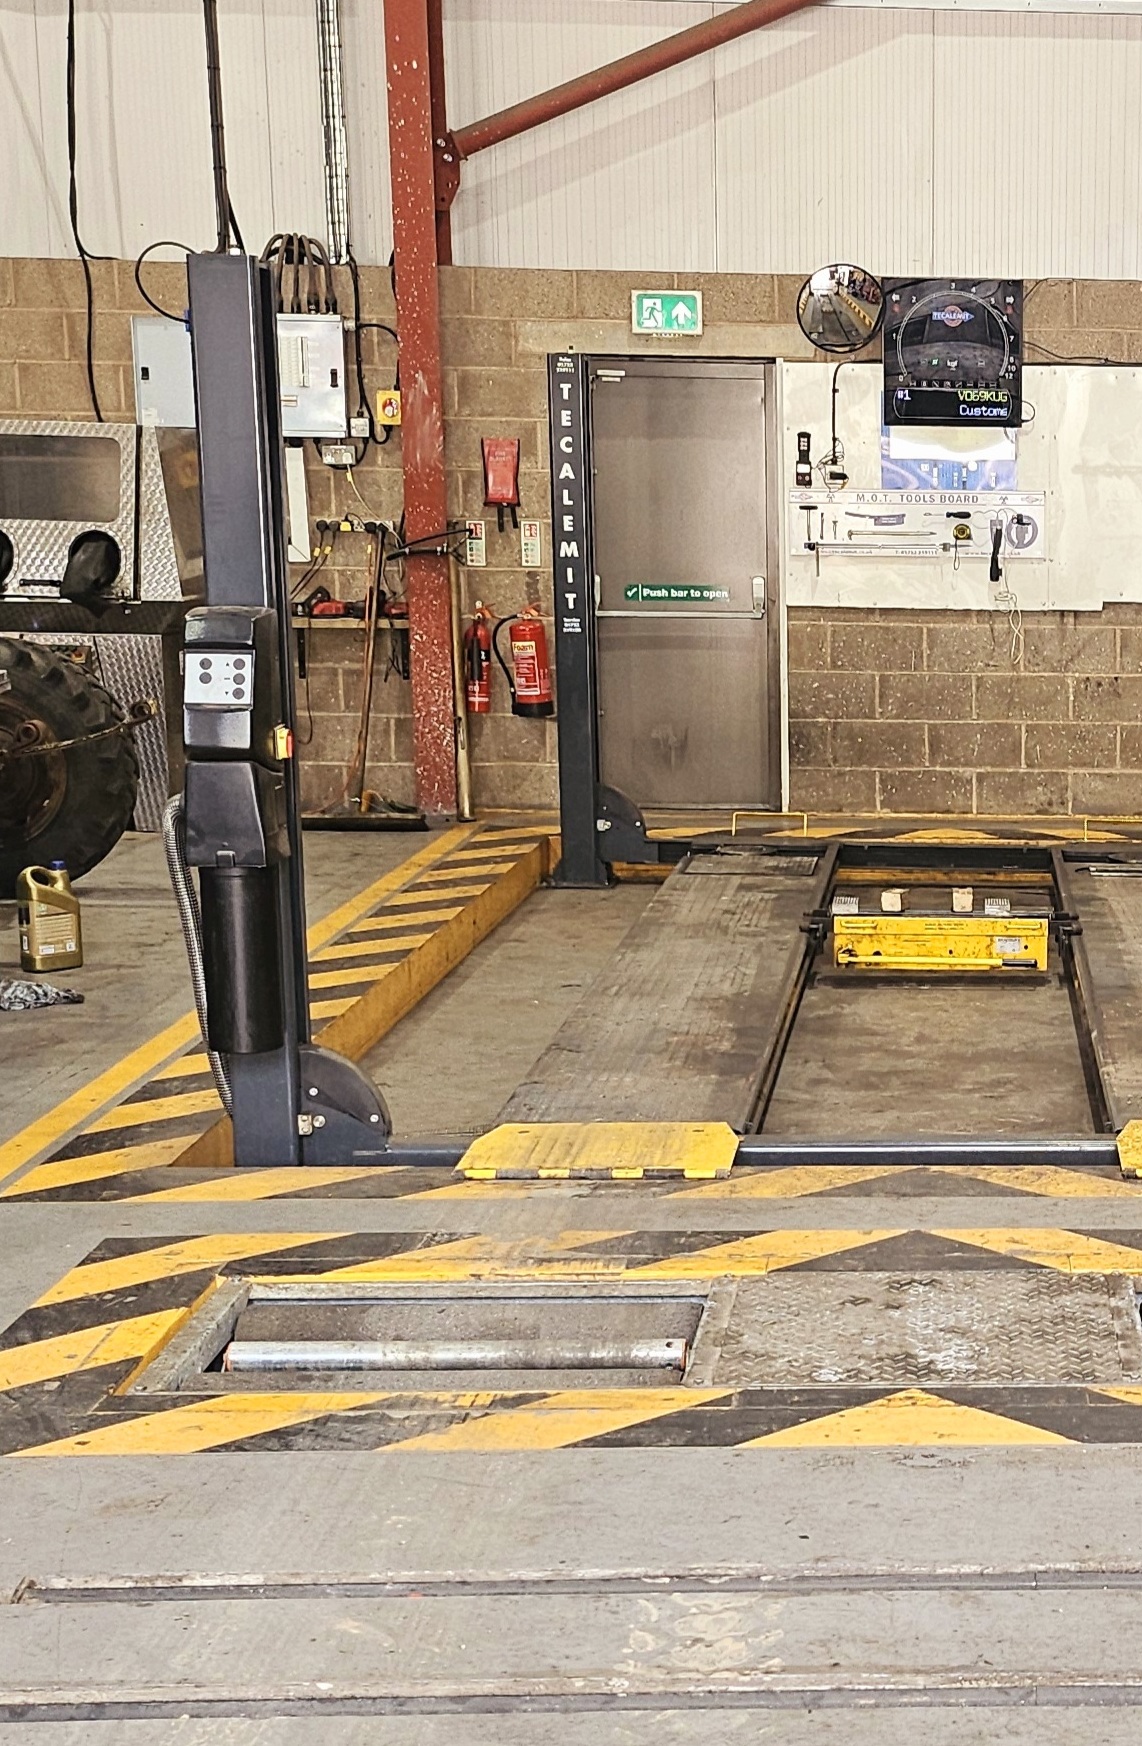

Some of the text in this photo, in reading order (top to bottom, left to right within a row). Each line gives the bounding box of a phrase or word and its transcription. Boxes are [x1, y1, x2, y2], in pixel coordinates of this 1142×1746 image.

[558, 383, 579, 609] TECALEMIT
[856, 493, 979, 503] M.O.T. TOOLS BOARD
[642, 588, 729, 600] Push bar to open
[513, 643, 534, 651] Foam
